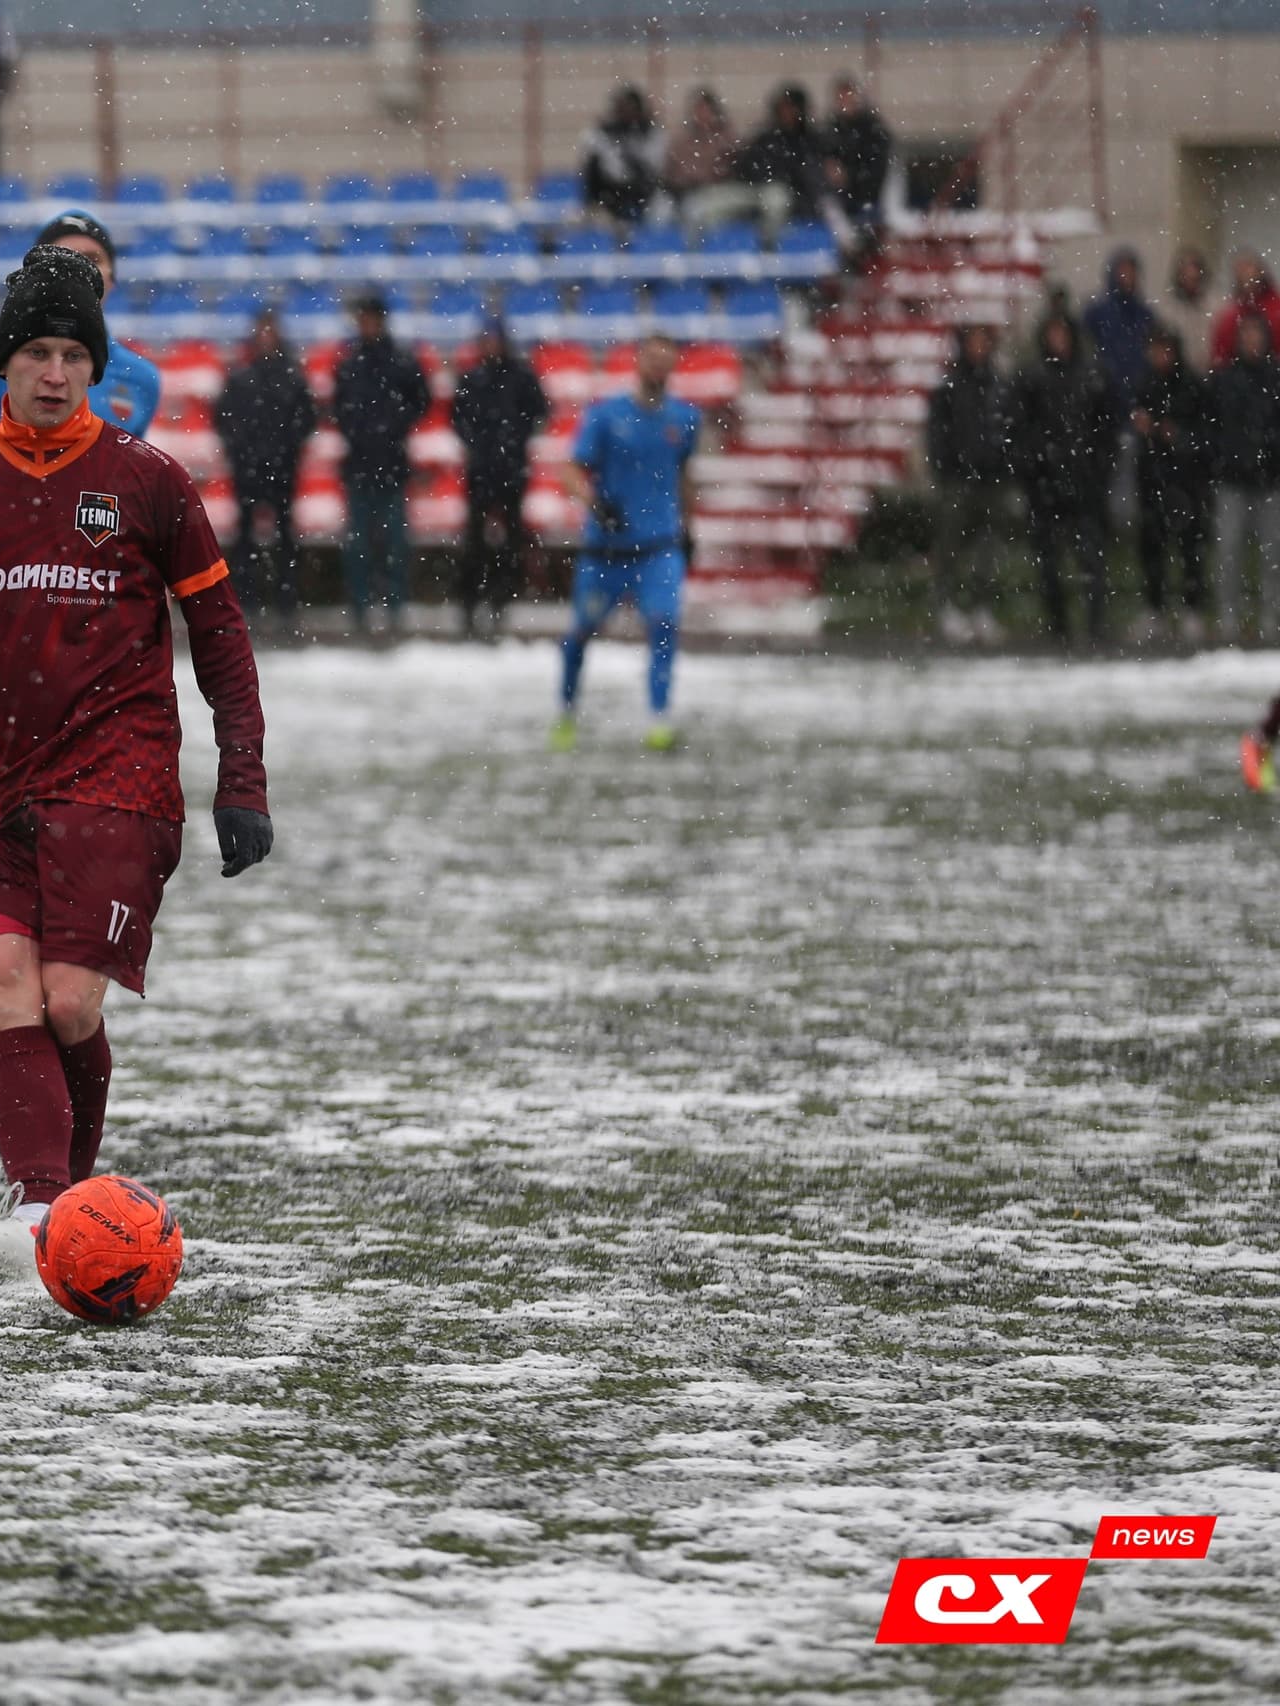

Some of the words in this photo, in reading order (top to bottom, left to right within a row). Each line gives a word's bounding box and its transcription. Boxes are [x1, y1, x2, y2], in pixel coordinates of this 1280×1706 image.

[80, 507, 115, 529] ТЕМП
[106, 899, 131, 945] 17
[78, 1203, 137, 1246] DEMIX
